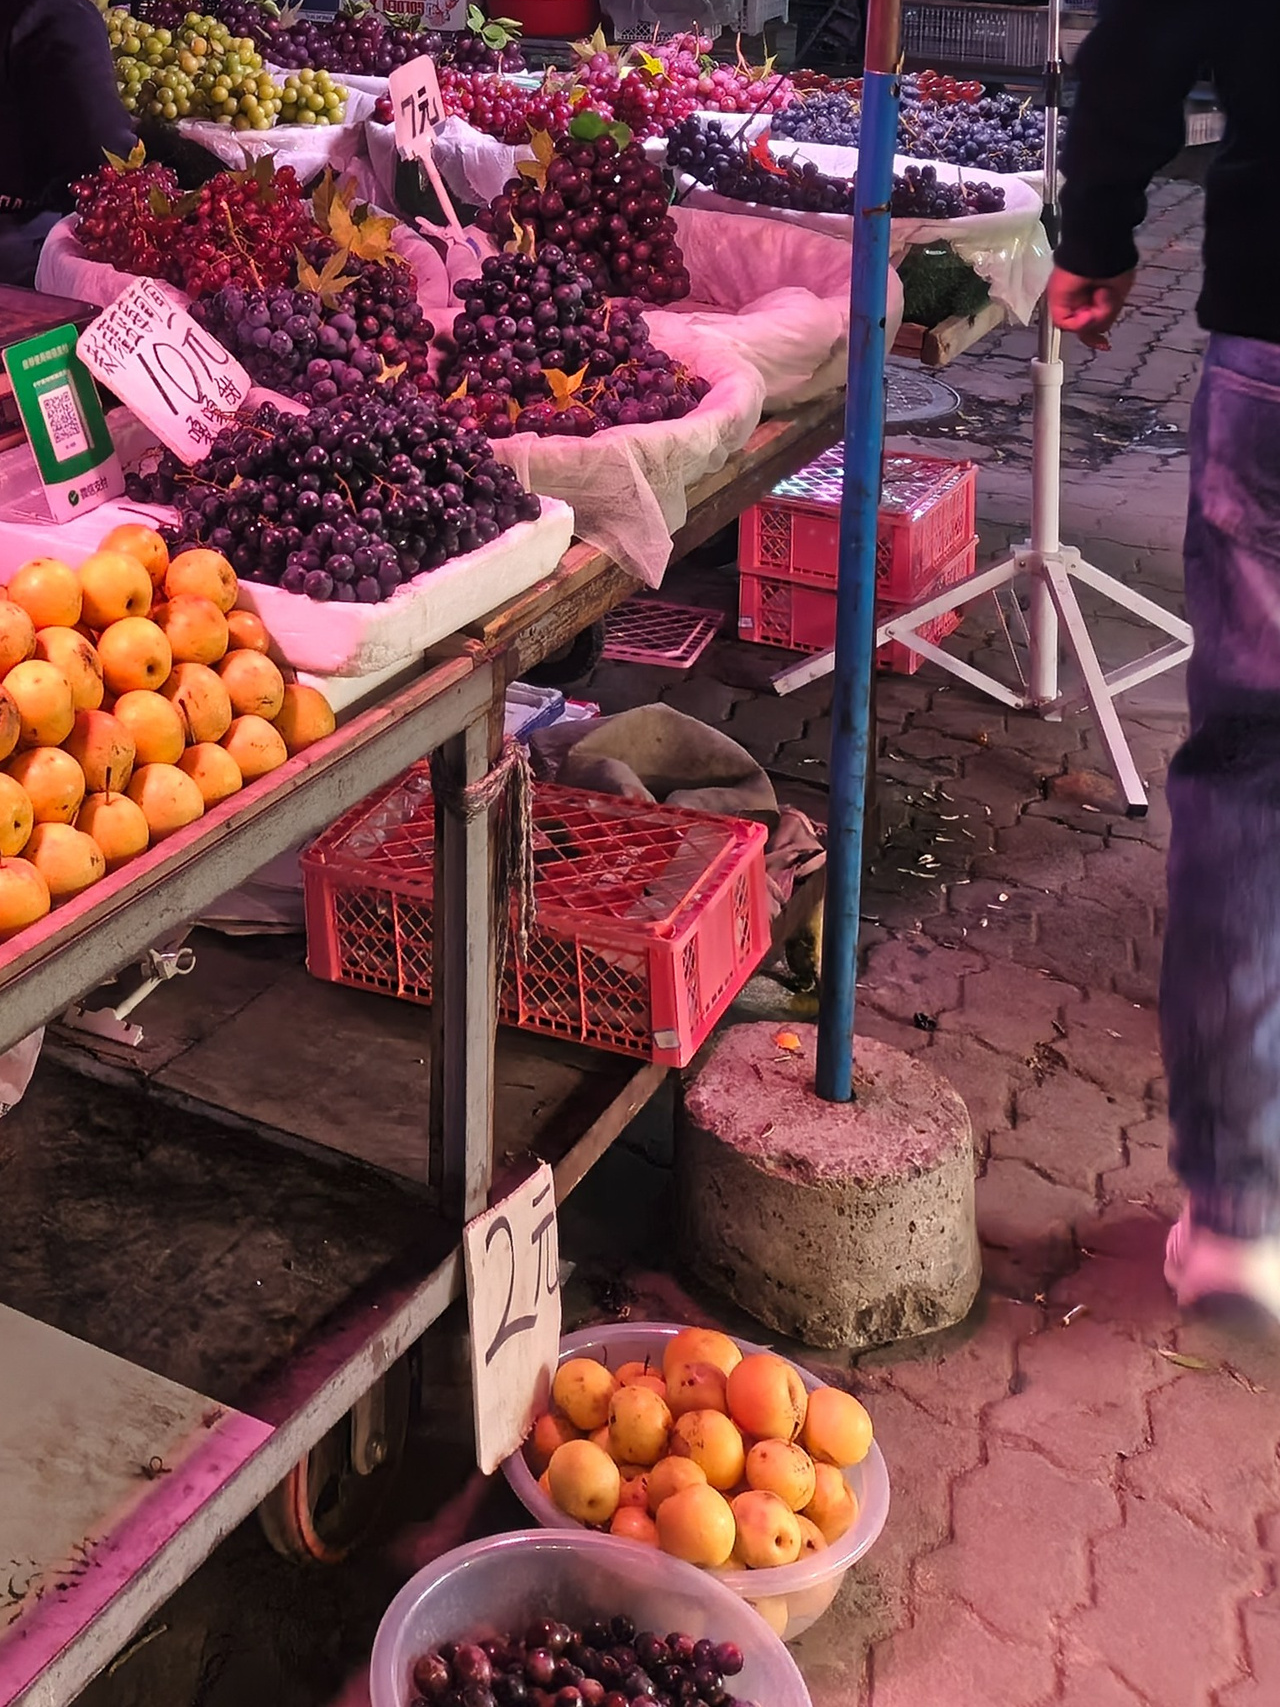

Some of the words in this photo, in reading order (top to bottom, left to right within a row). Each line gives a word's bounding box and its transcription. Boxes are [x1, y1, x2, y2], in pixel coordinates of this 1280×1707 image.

[382, 0, 425, 15] GOLDEN
[400, 85, 440, 139] 7元
[136, 312, 229, 417] 10元
[79, 476, 109, 501] 微信支付
[484, 1182, 558, 1368] 2元
